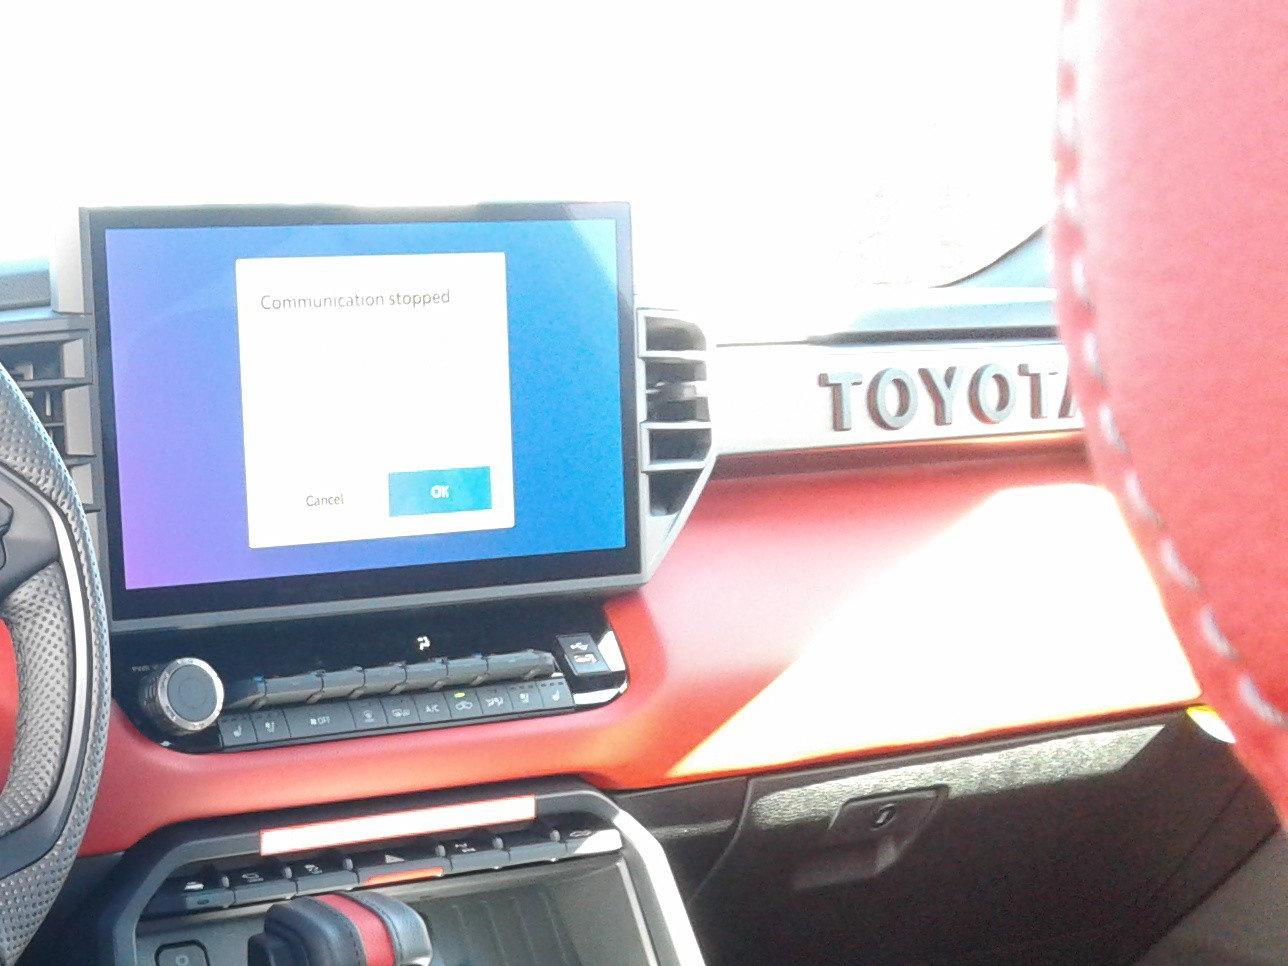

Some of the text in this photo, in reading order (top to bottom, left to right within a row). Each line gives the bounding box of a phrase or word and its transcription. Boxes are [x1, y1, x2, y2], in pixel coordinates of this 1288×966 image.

[260, 289, 451, 310] Communication stopped
[430, 485, 450, 500] OK
[305, 493, 345, 508] Cancel
